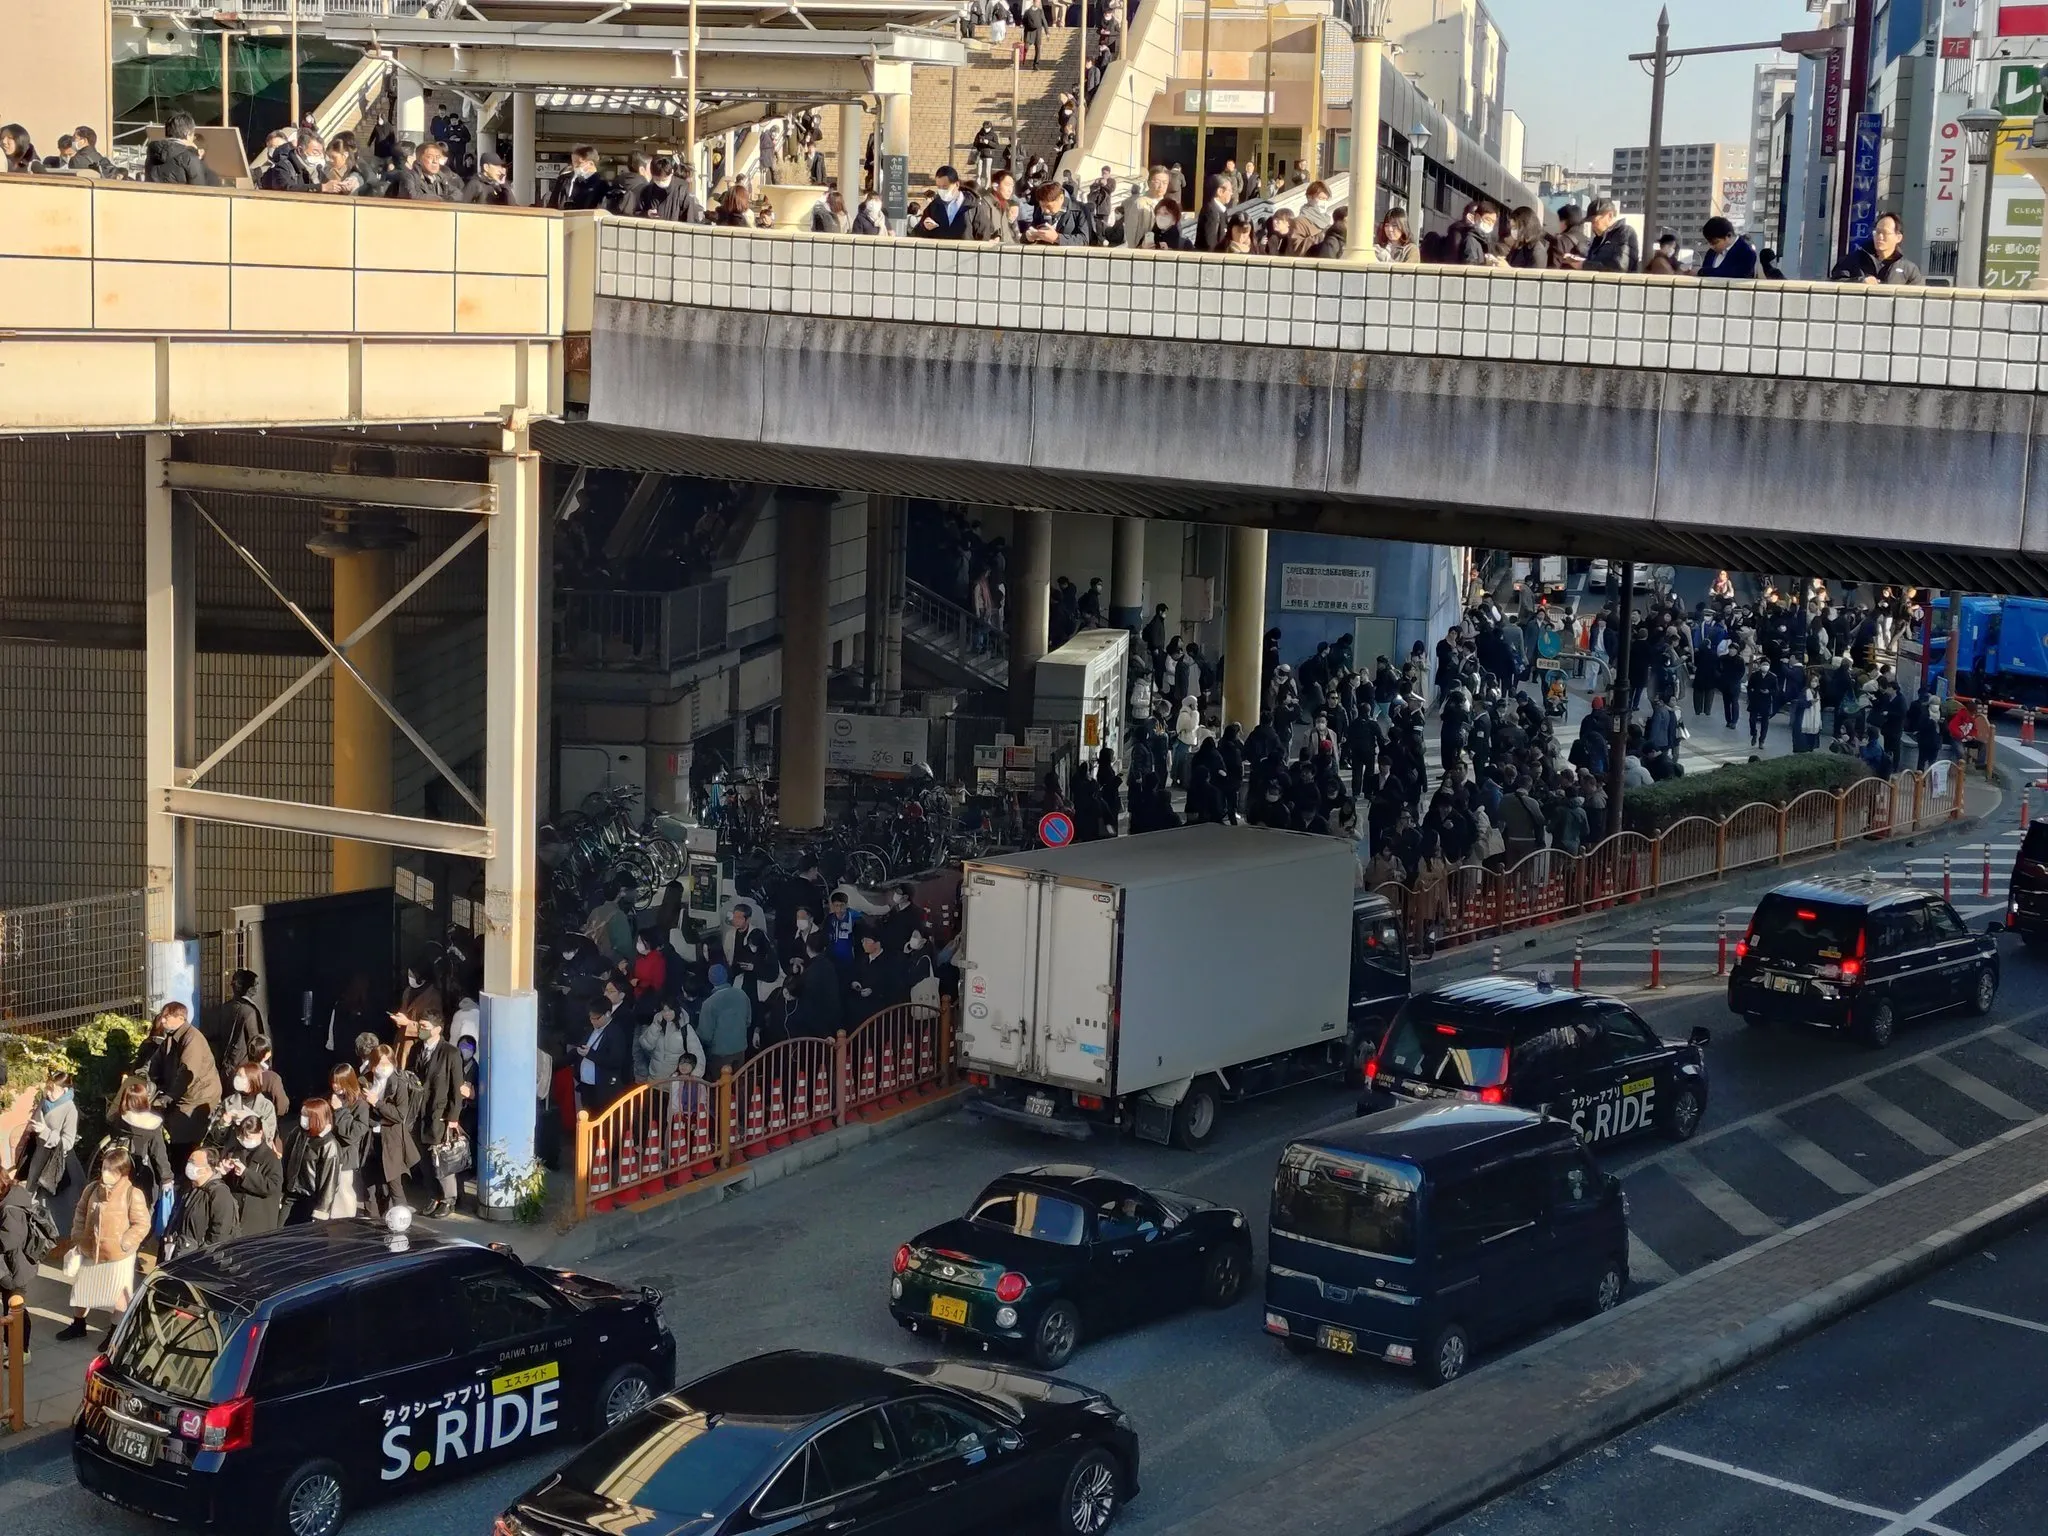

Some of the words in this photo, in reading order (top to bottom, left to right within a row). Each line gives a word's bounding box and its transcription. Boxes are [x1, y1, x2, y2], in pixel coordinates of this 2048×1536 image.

[1948, 41, 1965, 54] 7F
[1987, 243, 2001, 254] 4F
[1571, 1086, 1621, 1110] タクシーアプリ
[1570, 1090, 1656, 1144] S.RIDE
[499, 1347, 526, 1362] DAIWA
[529, 1341, 549, 1354] TAXI
[503, 1367, 548, 1389] エスライド
[382, 1382, 486, 1427] タクシーアプリ
[380, 1380, 560, 1481] S.RIDE
